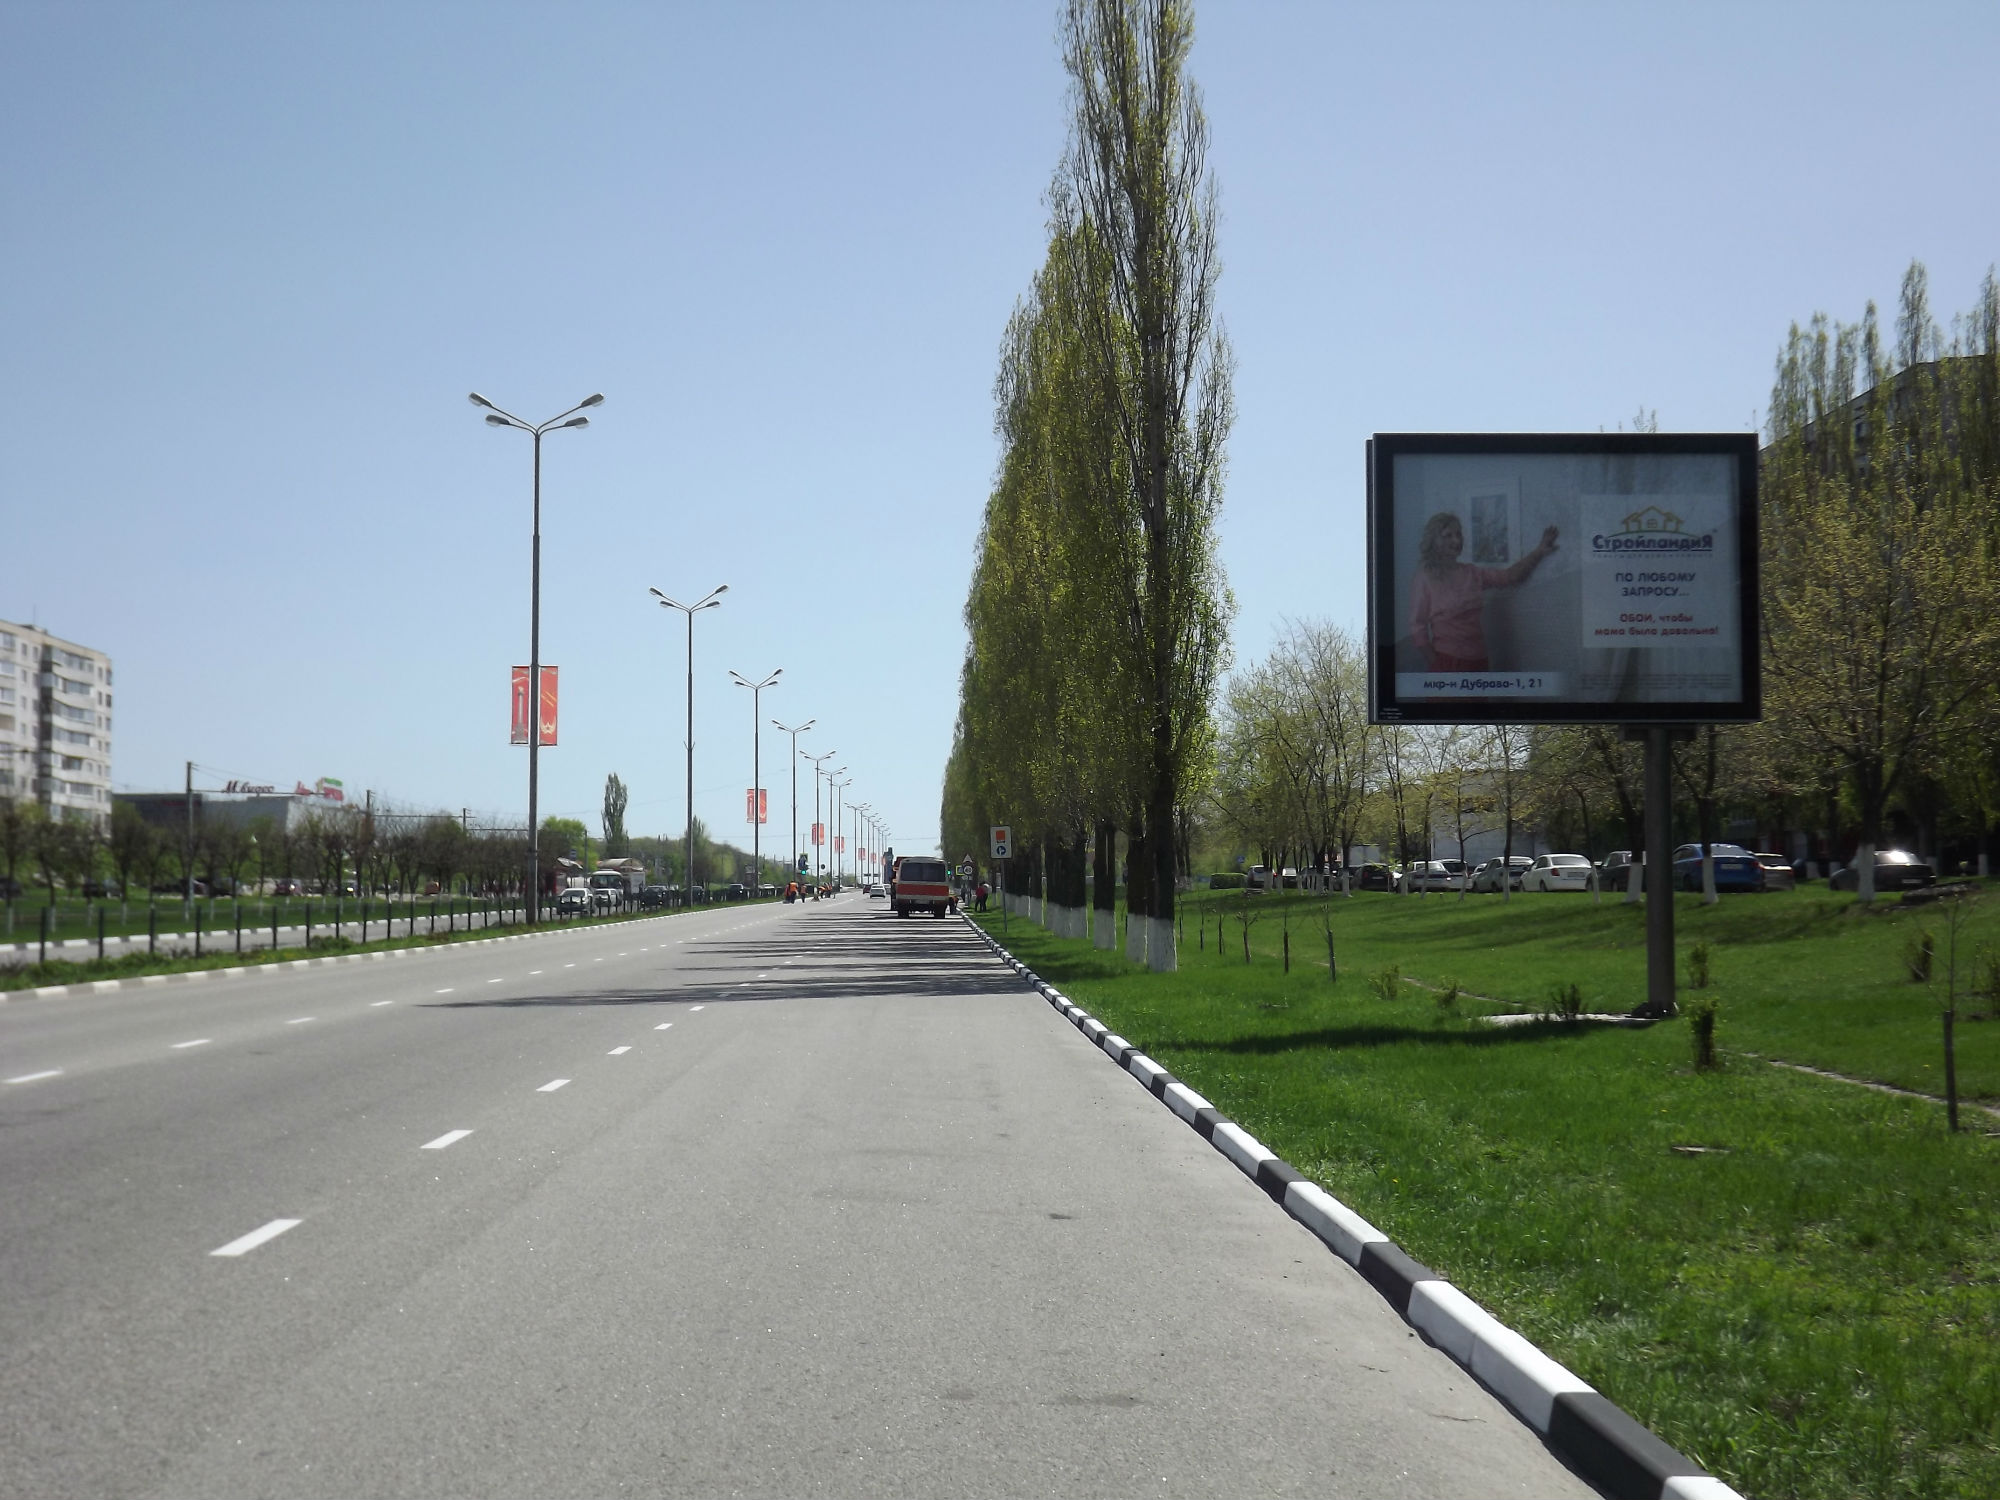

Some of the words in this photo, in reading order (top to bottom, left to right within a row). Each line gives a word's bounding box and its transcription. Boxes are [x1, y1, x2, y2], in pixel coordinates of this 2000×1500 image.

[1615, 573, 1634, 582] ПО
[1638, 573, 1696, 582] ЛЮБОМУ
[1620, 613, 1656, 623] ОБОИ,
[1659, 613, 1693, 622] чтобы
[1629, 627, 1658, 636] была
[1424, 680, 1457, 690] мкр-н
[1529, 679, 1543, 687] 21
